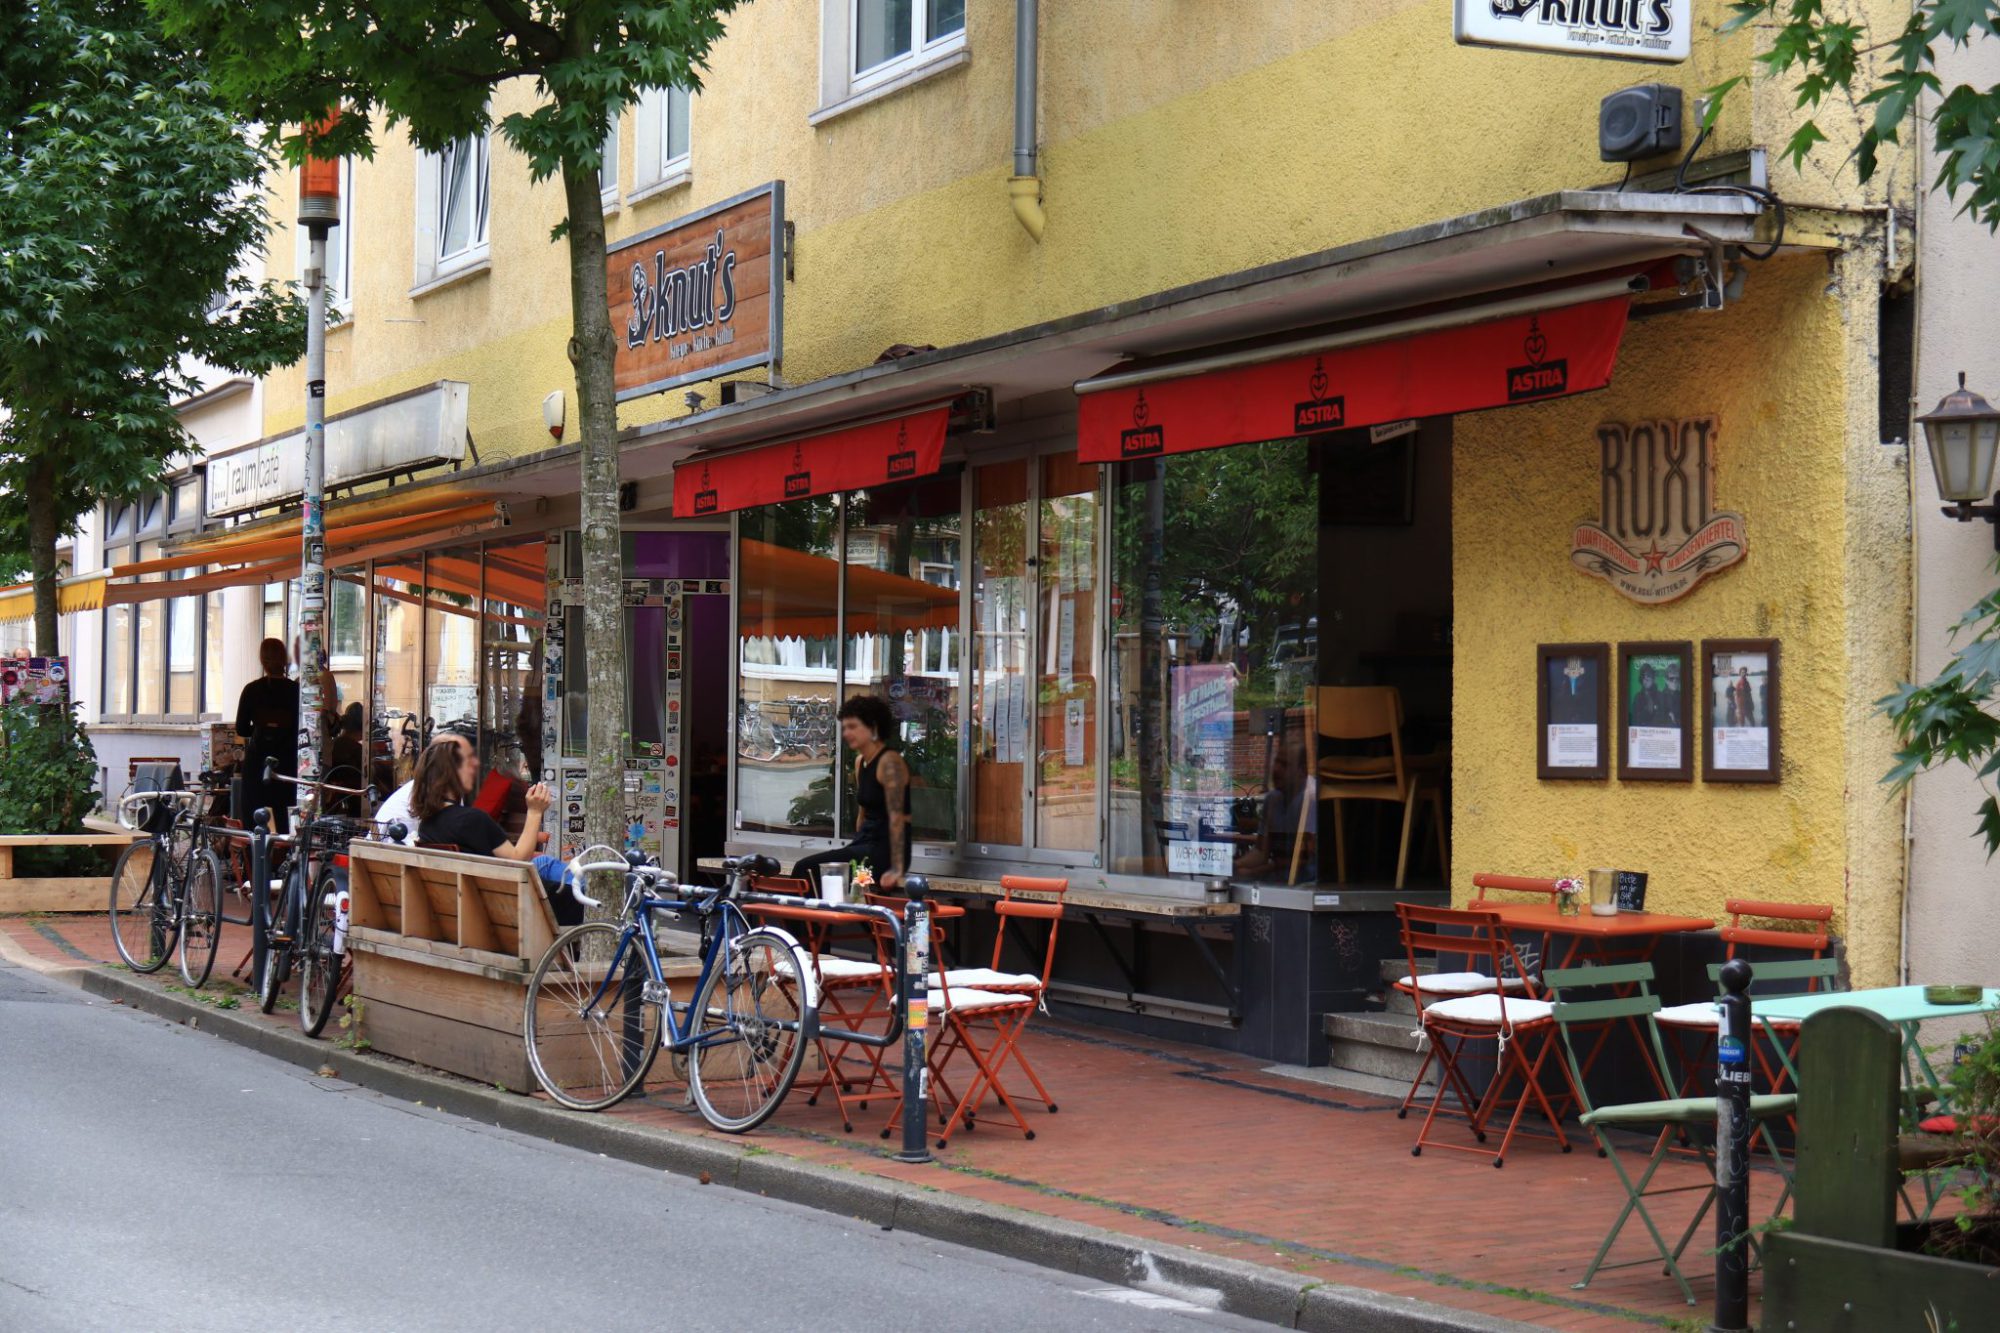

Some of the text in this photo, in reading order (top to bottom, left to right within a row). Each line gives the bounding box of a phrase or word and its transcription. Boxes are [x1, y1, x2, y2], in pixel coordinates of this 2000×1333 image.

[653, 229, 735, 342] knut's
[1512, 369, 1564, 393] ASTRA
[1298, 404, 1341, 426] ASTRA
[1124, 432, 1160, 451] ASTRA
[889, 457, 915, 475] ASTRA
[785, 476, 810, 495] ASTRA
[1596, 420, 1713, 540] ROXI
[695, 494, 717, 509] ASTRA
